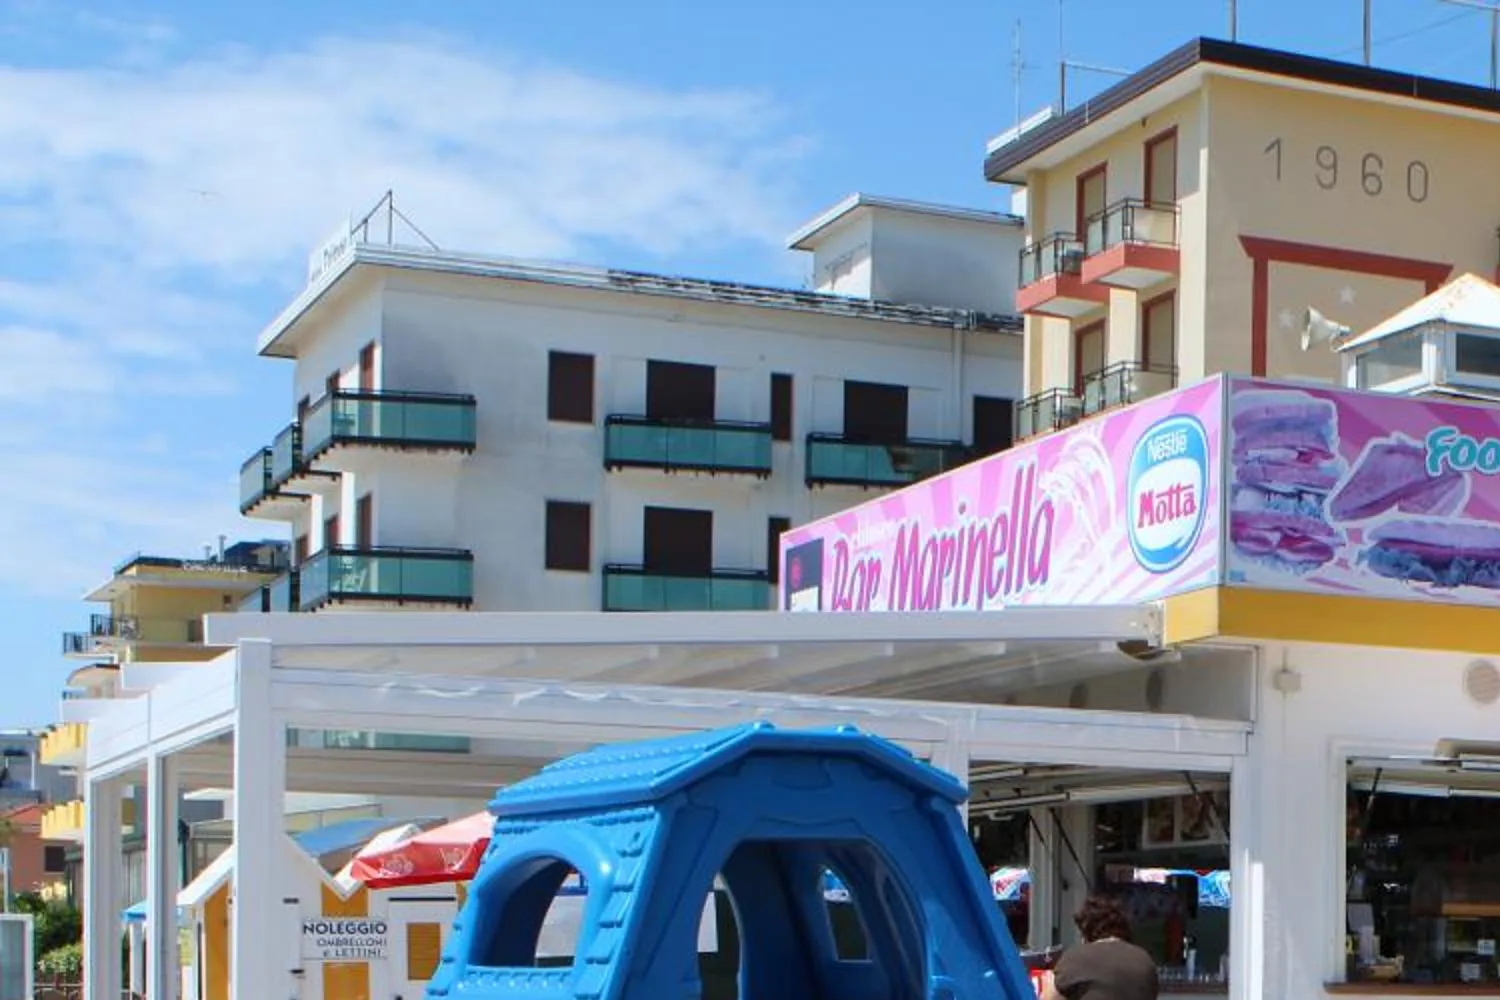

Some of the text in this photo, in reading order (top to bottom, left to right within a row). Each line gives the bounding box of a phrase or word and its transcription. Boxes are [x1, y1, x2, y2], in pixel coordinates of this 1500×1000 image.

[1263, 137, 1430, 203] 1960
[1137, 483, 1198, 529] Motta
[831, 462, 1054, 611] Bar Marinella
[303, 922, 387, 935] NOLEGGIO
